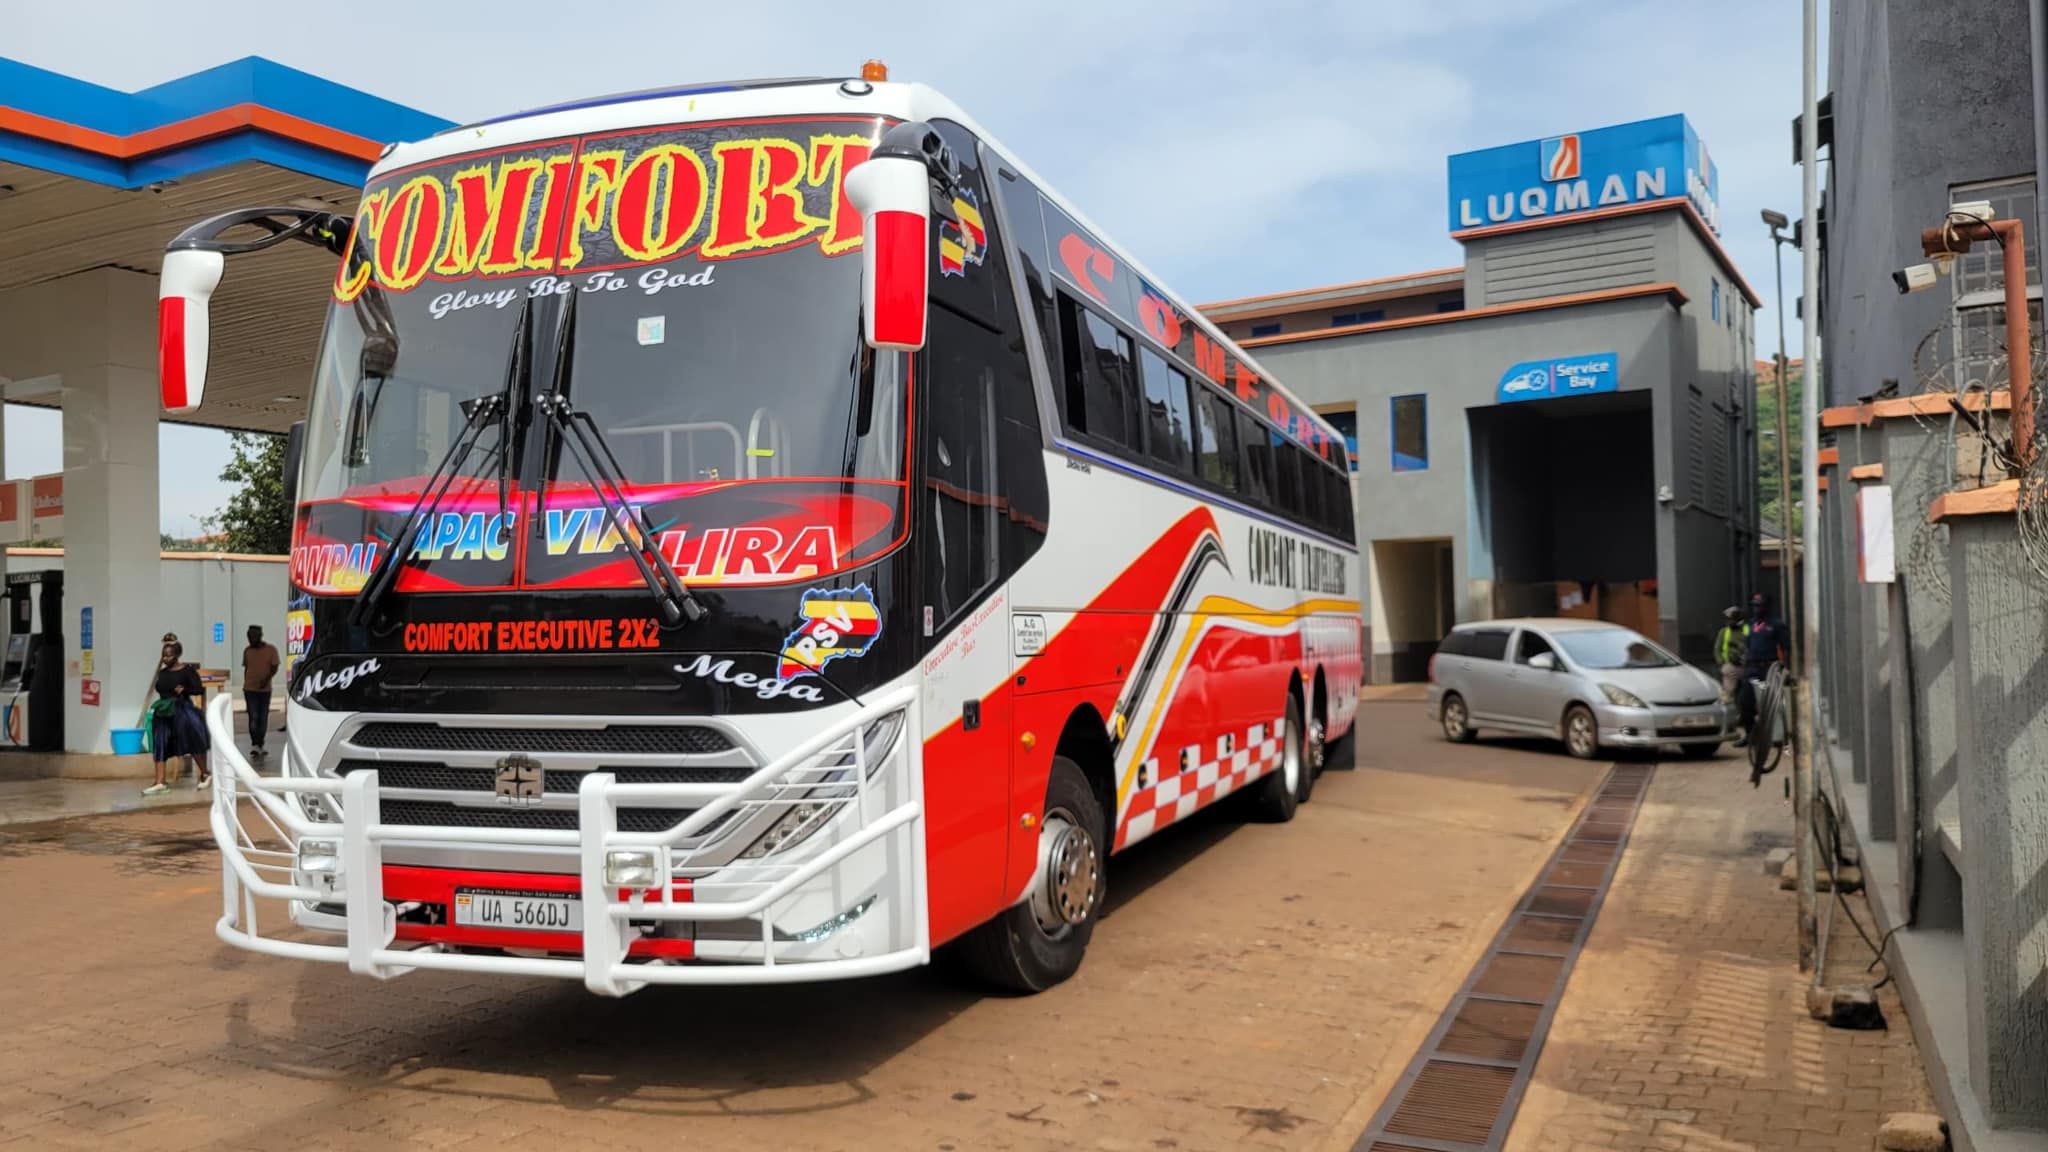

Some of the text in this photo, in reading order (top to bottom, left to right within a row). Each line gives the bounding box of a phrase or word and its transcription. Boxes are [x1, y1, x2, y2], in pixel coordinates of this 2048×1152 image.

[334, 131, 872, 302] COMFORT
[1460, 167, 1666, 227] LUQMAN
[428, 264, 716, 320] Glory Be To God
[1556, 361, 1609, 377] Service
[1569, 376, 1597, 389] Bay
[290, 526, 838, 588] AMPAL LIRA
[408, 505, 645, 561] APAC VIA
[290, 617, 305, 640] 80
[404, 618, 661, 651] COMFORT EXECUTIVE 2X2
[795, 605, 854, 663] PSV
[297, 657, 382, 701] Mega
[673, 654, 824, 702] Mega
[481, 898, 570, 927] UA 566DJ
